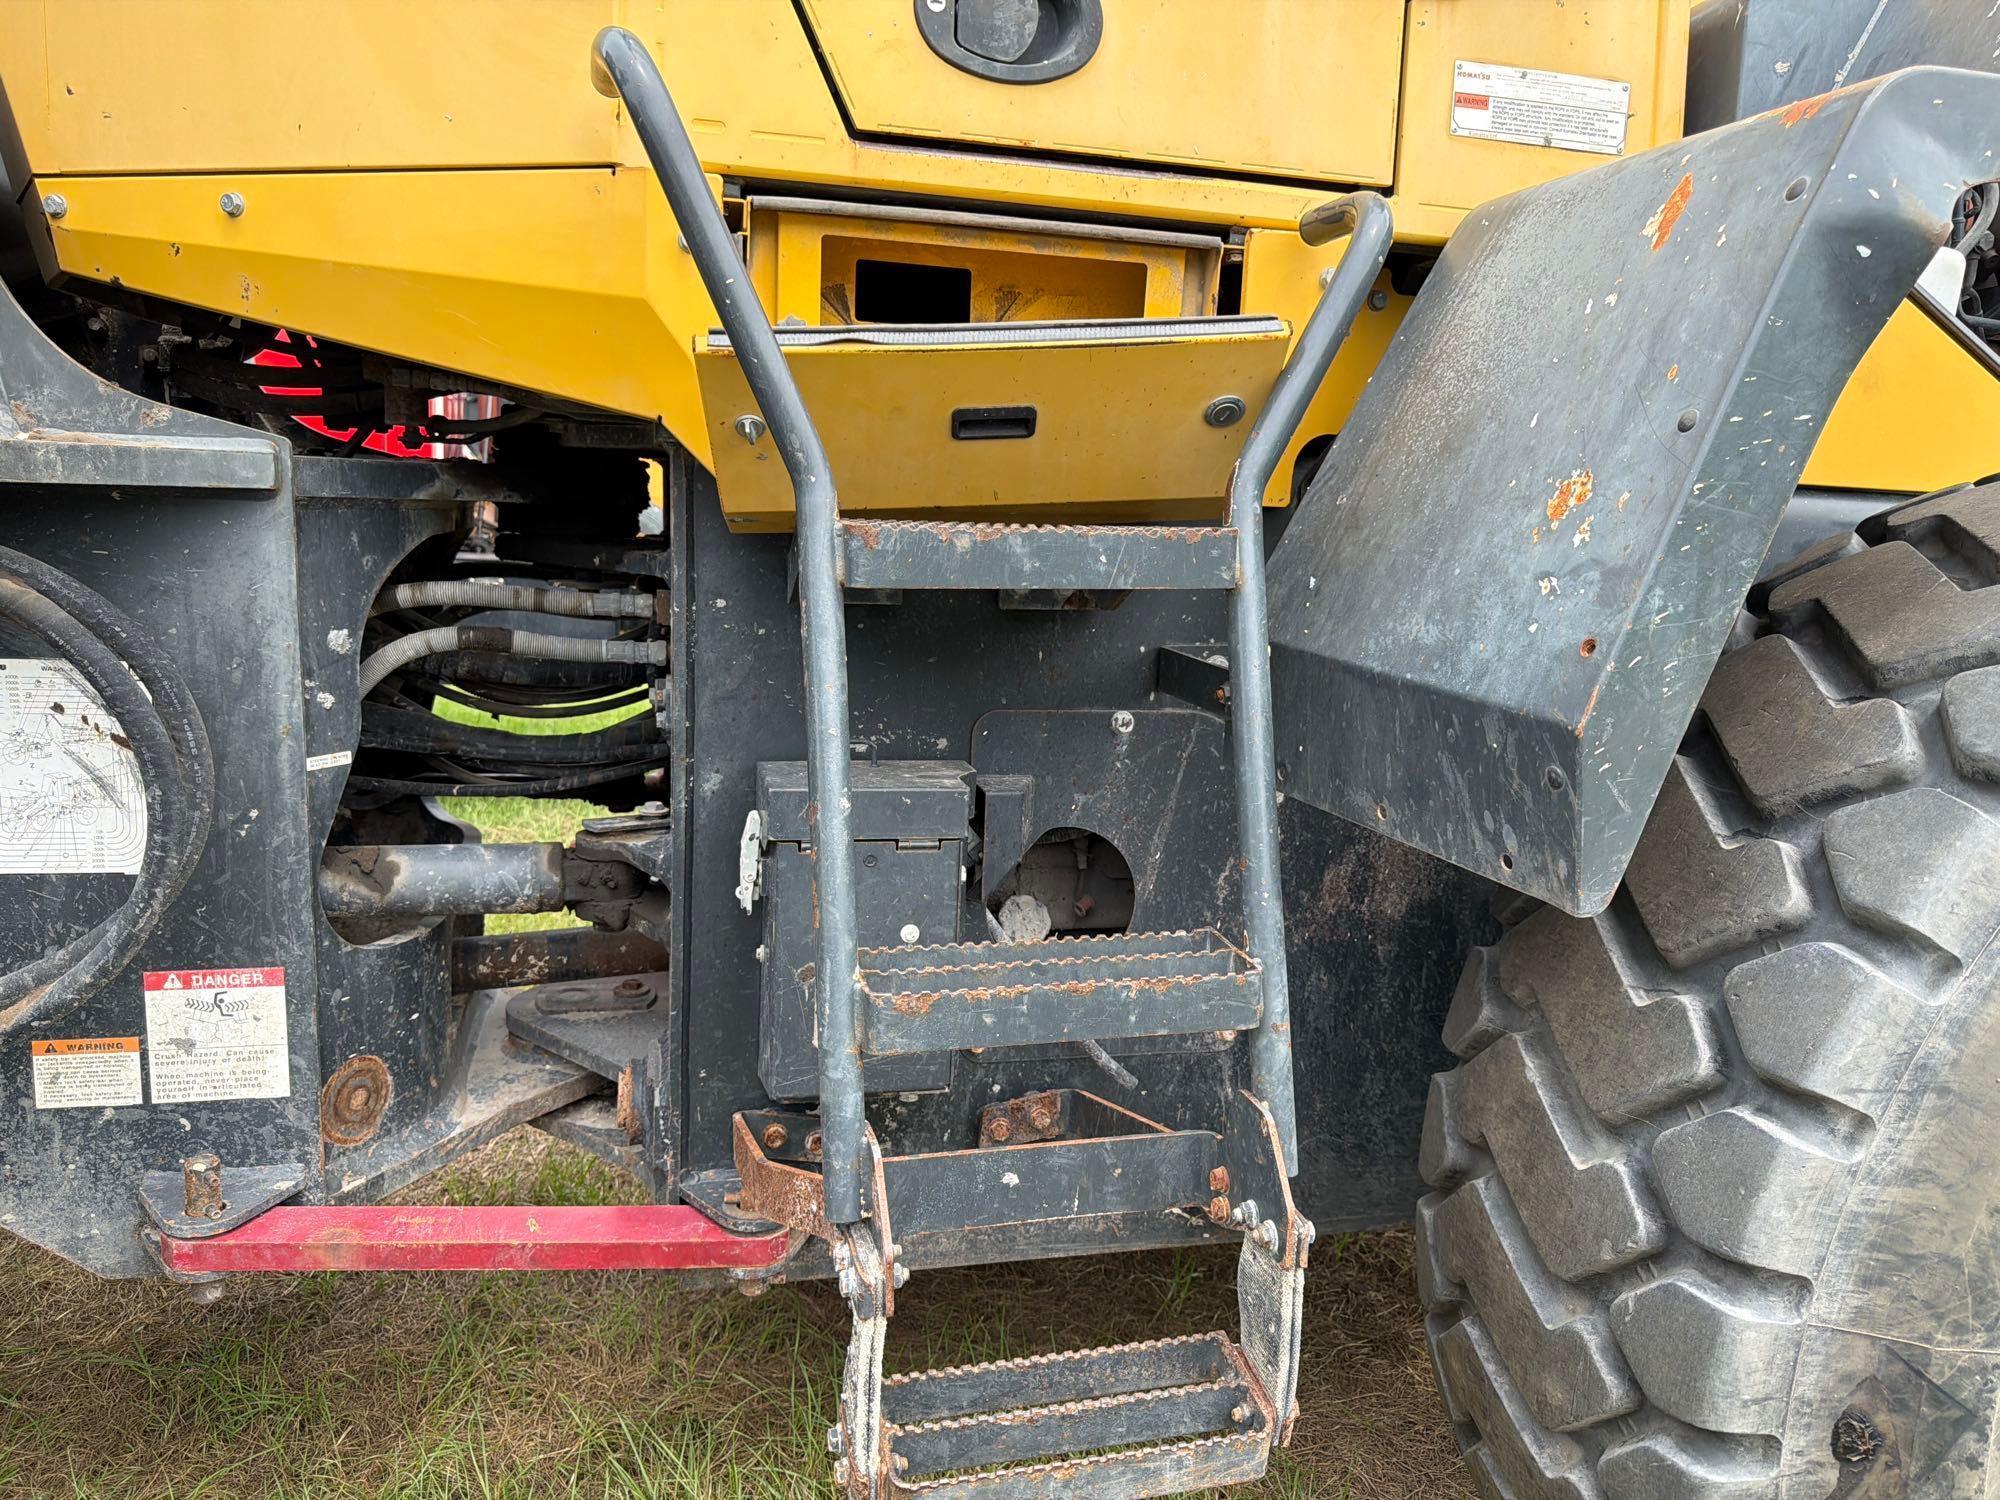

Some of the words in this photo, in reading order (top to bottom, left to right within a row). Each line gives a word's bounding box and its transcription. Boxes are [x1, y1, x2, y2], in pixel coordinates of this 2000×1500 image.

[1457, 71, 1490, 80] KOMATSU
[1463, 96, 1488, 107] WARNING
[191, 973, 264, 987] DANGER
[66, 1042, 124, 1052] WARNING
[154, 1052, 181, 1060] Crush
[189, 1058, 217, 1067] injury
[156, 1073, 181, 1081] When
[186, 1071, 224, 1079] machine
[242, 1069, 267, 1077] being
[235, 1076, 259, 1084] place
[156, 1086, 195, 1094] yourself
[196, 1090, 237, 1098] machine.
